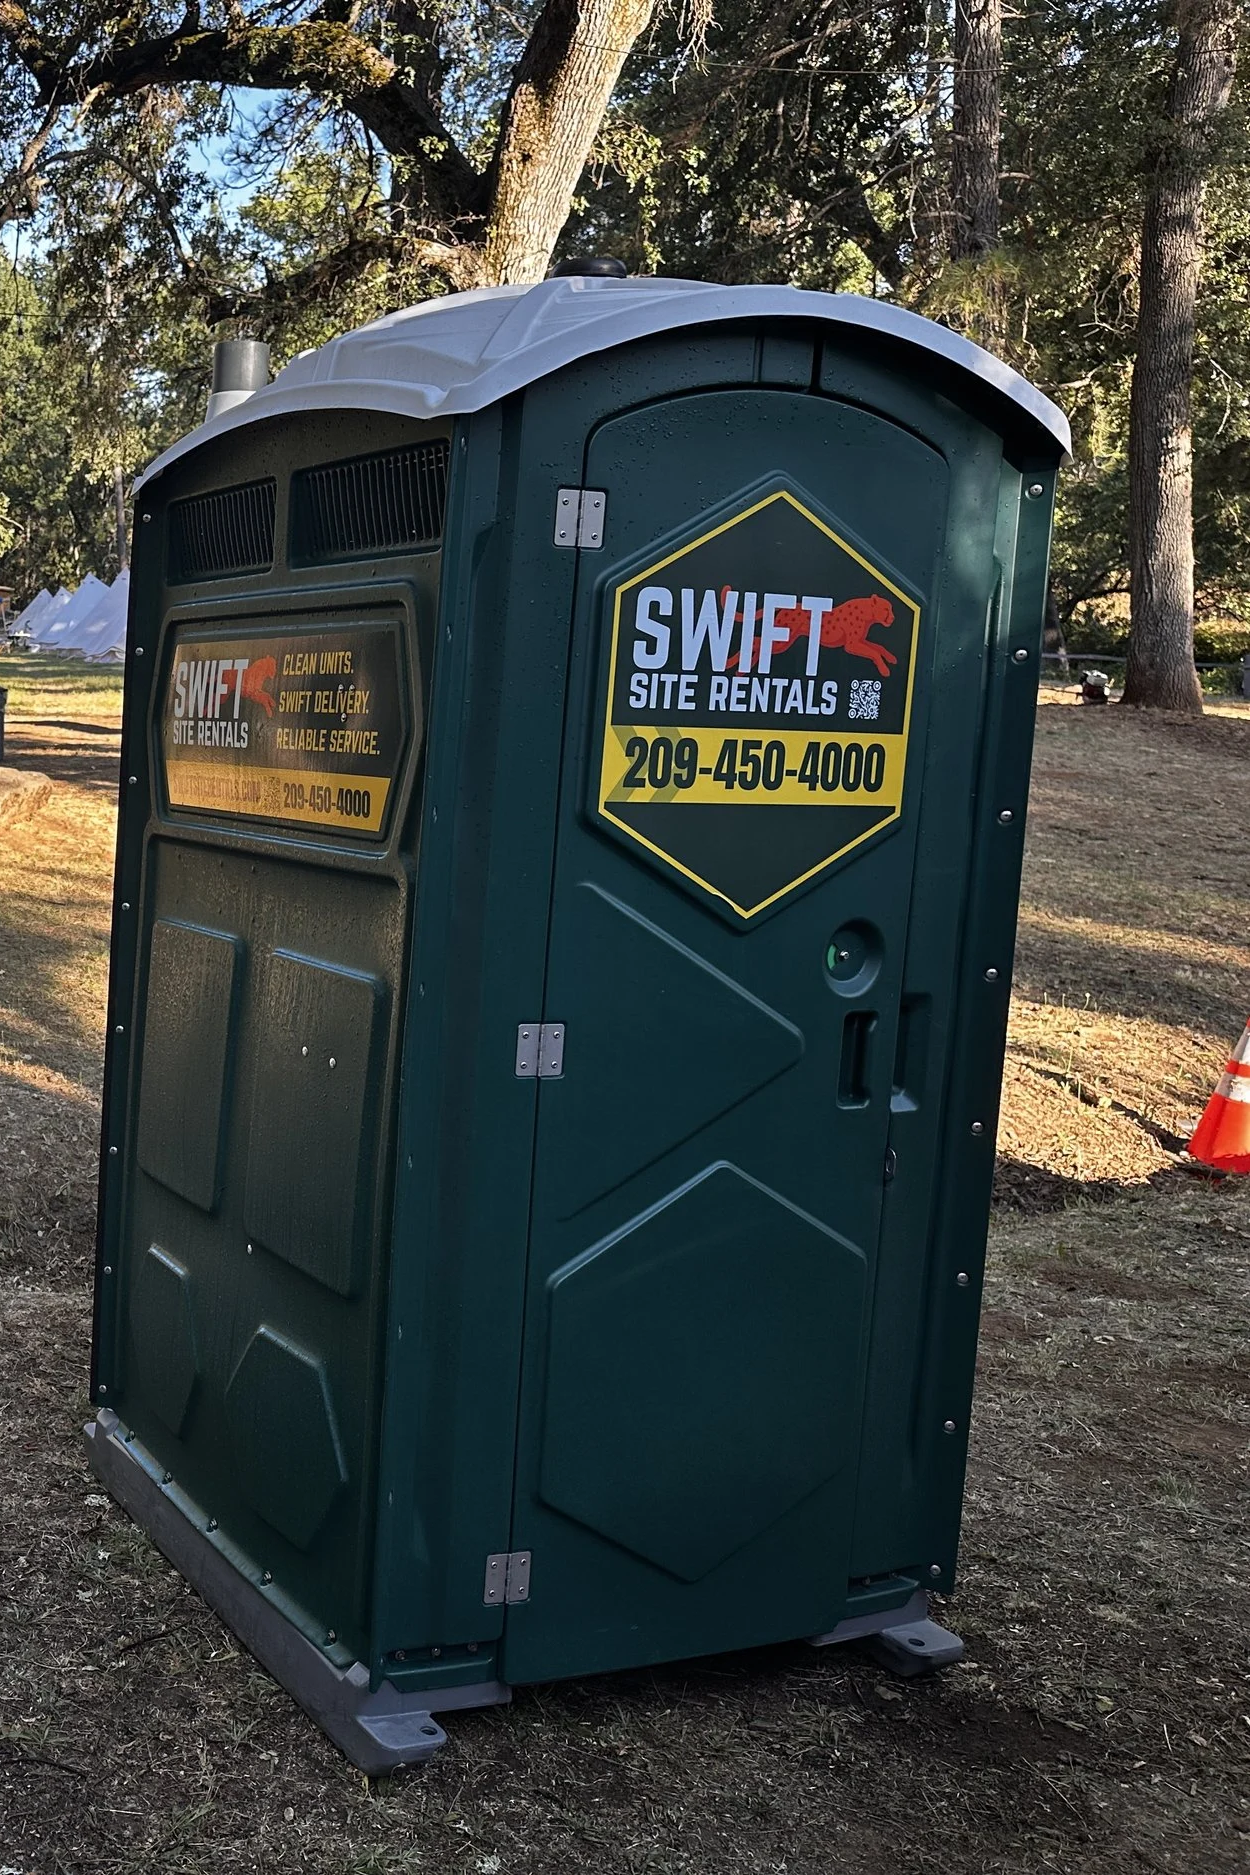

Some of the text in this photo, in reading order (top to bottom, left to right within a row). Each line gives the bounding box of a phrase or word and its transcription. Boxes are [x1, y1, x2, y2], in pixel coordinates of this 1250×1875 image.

[632, 586, 833, 676] SWIFT
[282, 651, 354, 675] CLEAN UNITS.
[174, 659, 249, 718] SWIFT
[278, 690, 369, 714] SWIFT DELIVERY.
[629, 673, 838, 715] SITE RENTALS
[173, 720, 249, 748] SITE RENTALS
[276, 729, 381, 755] RELIABLE SERVICE.
[622, 736, 885, 792] 209-450-4000
[283, 783, 371, 818] 209-450-4000
